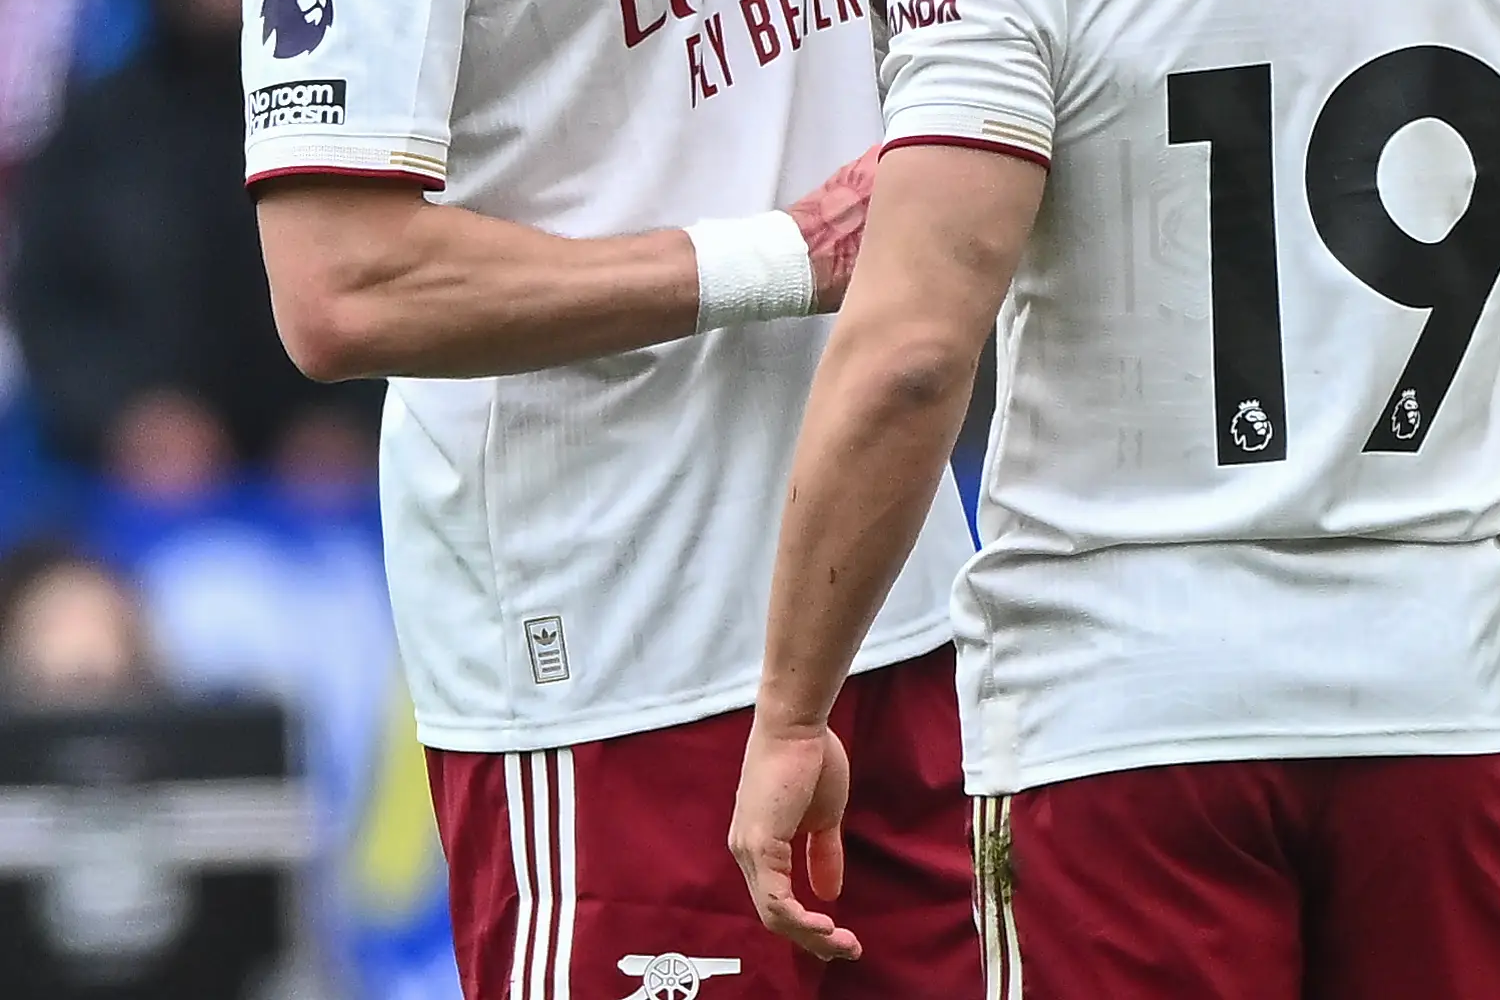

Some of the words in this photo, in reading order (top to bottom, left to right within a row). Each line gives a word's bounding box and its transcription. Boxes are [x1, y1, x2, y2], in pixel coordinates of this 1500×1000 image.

[249, 90, 270, 113] No
[271, 84, 334, 108] room
[269, 106, 344, 126] racism
